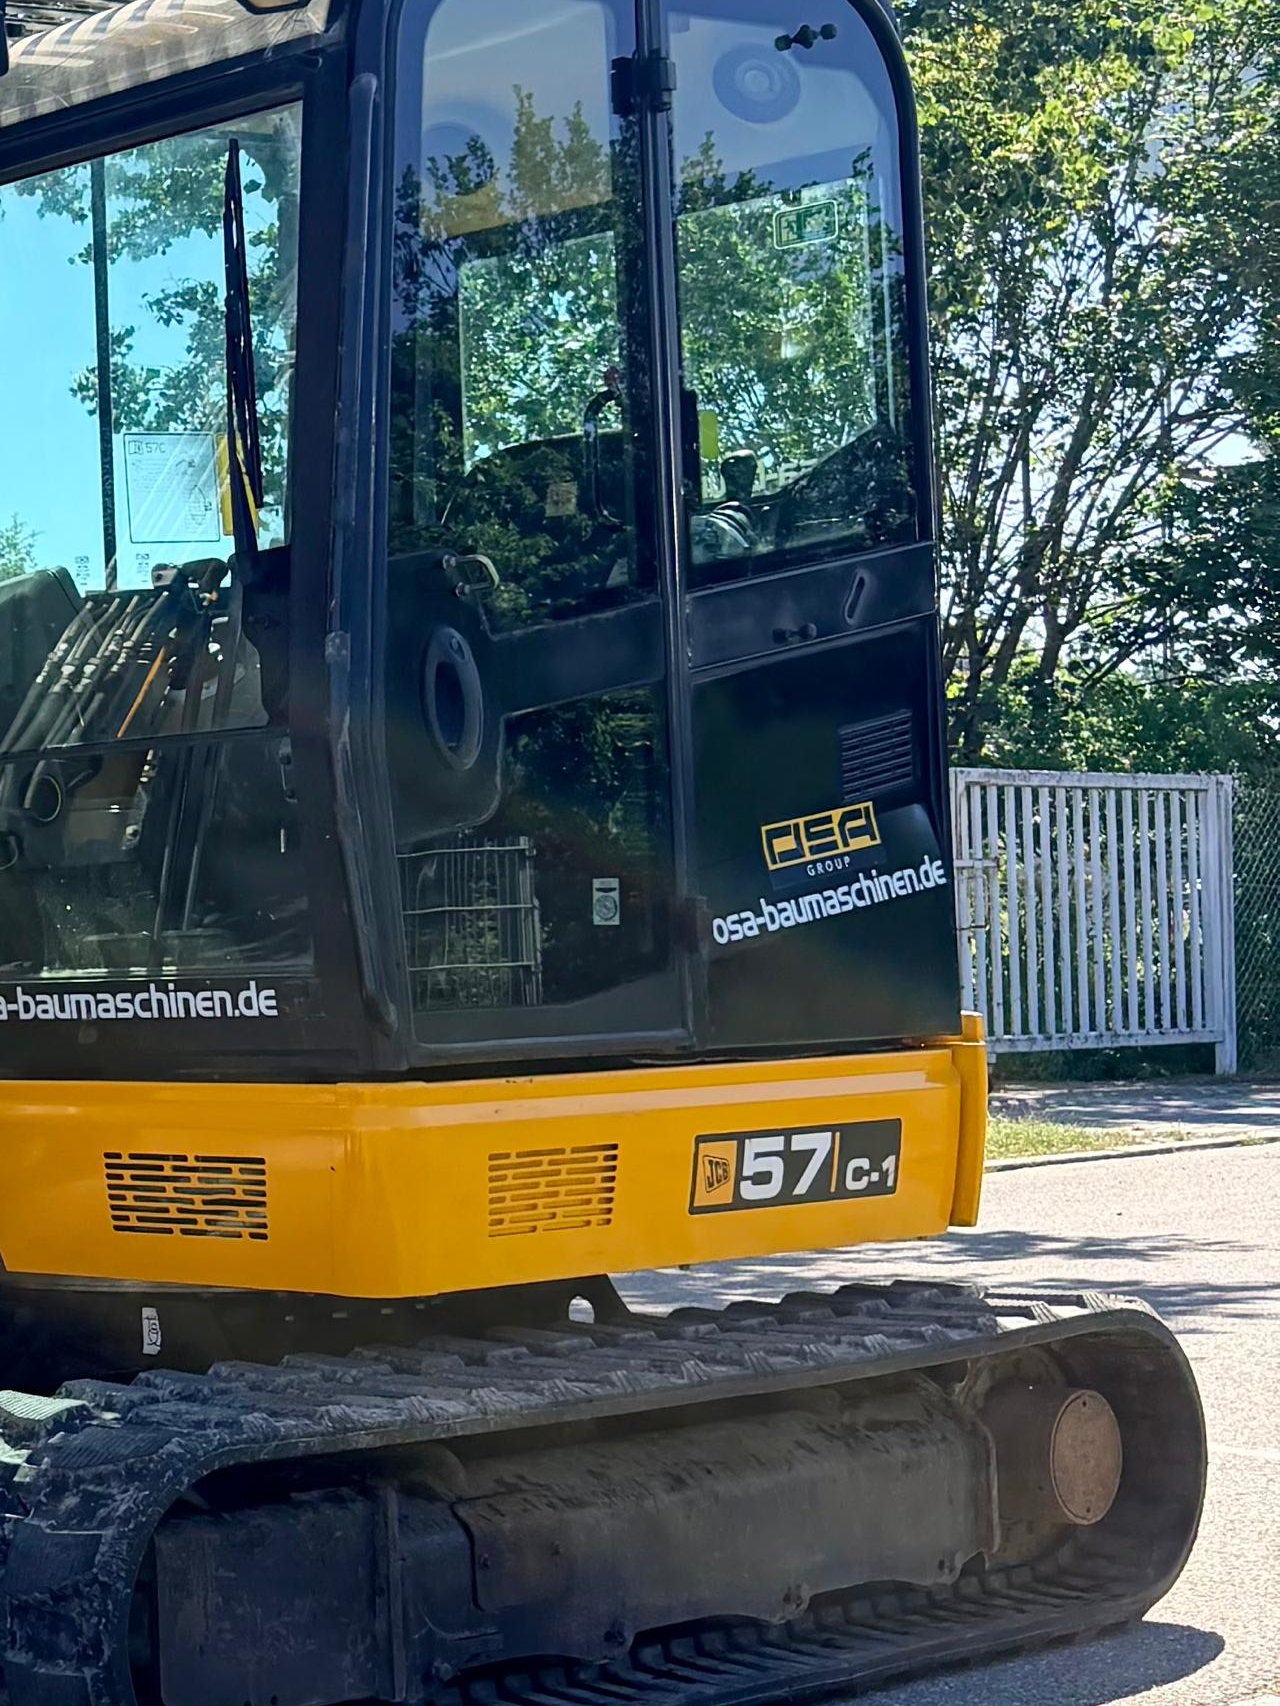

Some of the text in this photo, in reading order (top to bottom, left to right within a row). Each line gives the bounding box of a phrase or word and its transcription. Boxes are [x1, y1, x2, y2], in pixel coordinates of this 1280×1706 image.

[712, 855, 947, 944] osa-baumaschinen.de
[807, 855, 851, 877] GROUP
[706, 1131, 896, 1200] JCB 57 C-1
